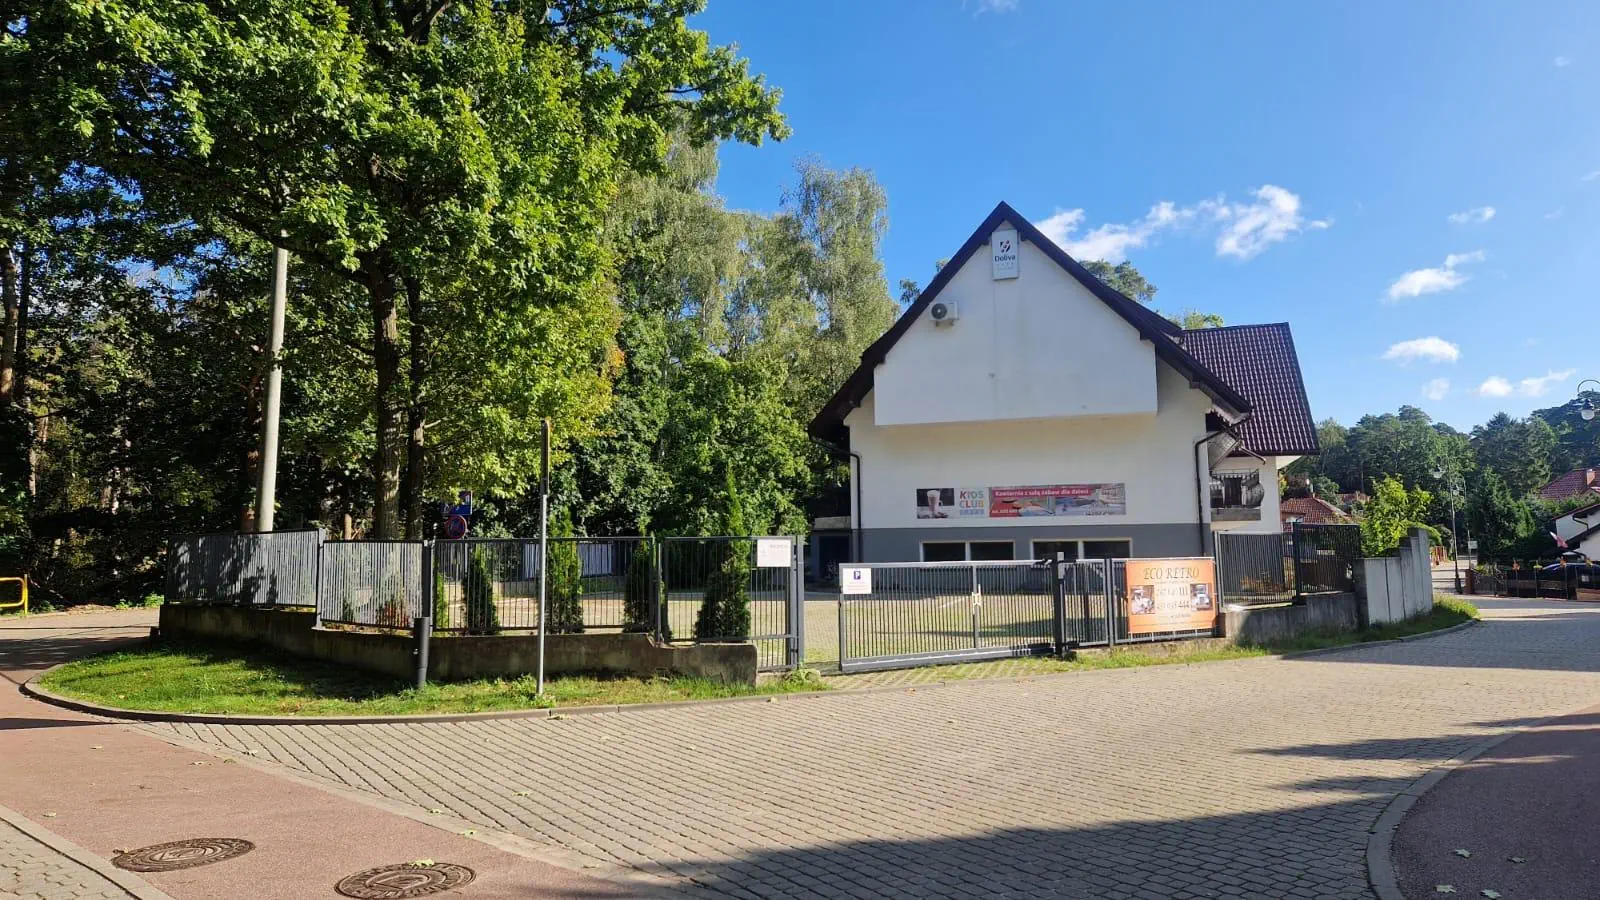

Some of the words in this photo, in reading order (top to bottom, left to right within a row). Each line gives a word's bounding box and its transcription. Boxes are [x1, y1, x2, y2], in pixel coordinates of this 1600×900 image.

[960, 500, 984, 509] CLUB
[1144, 567, 1163, 580] ECO
[1166, 566, 1200, 579] RETRO
